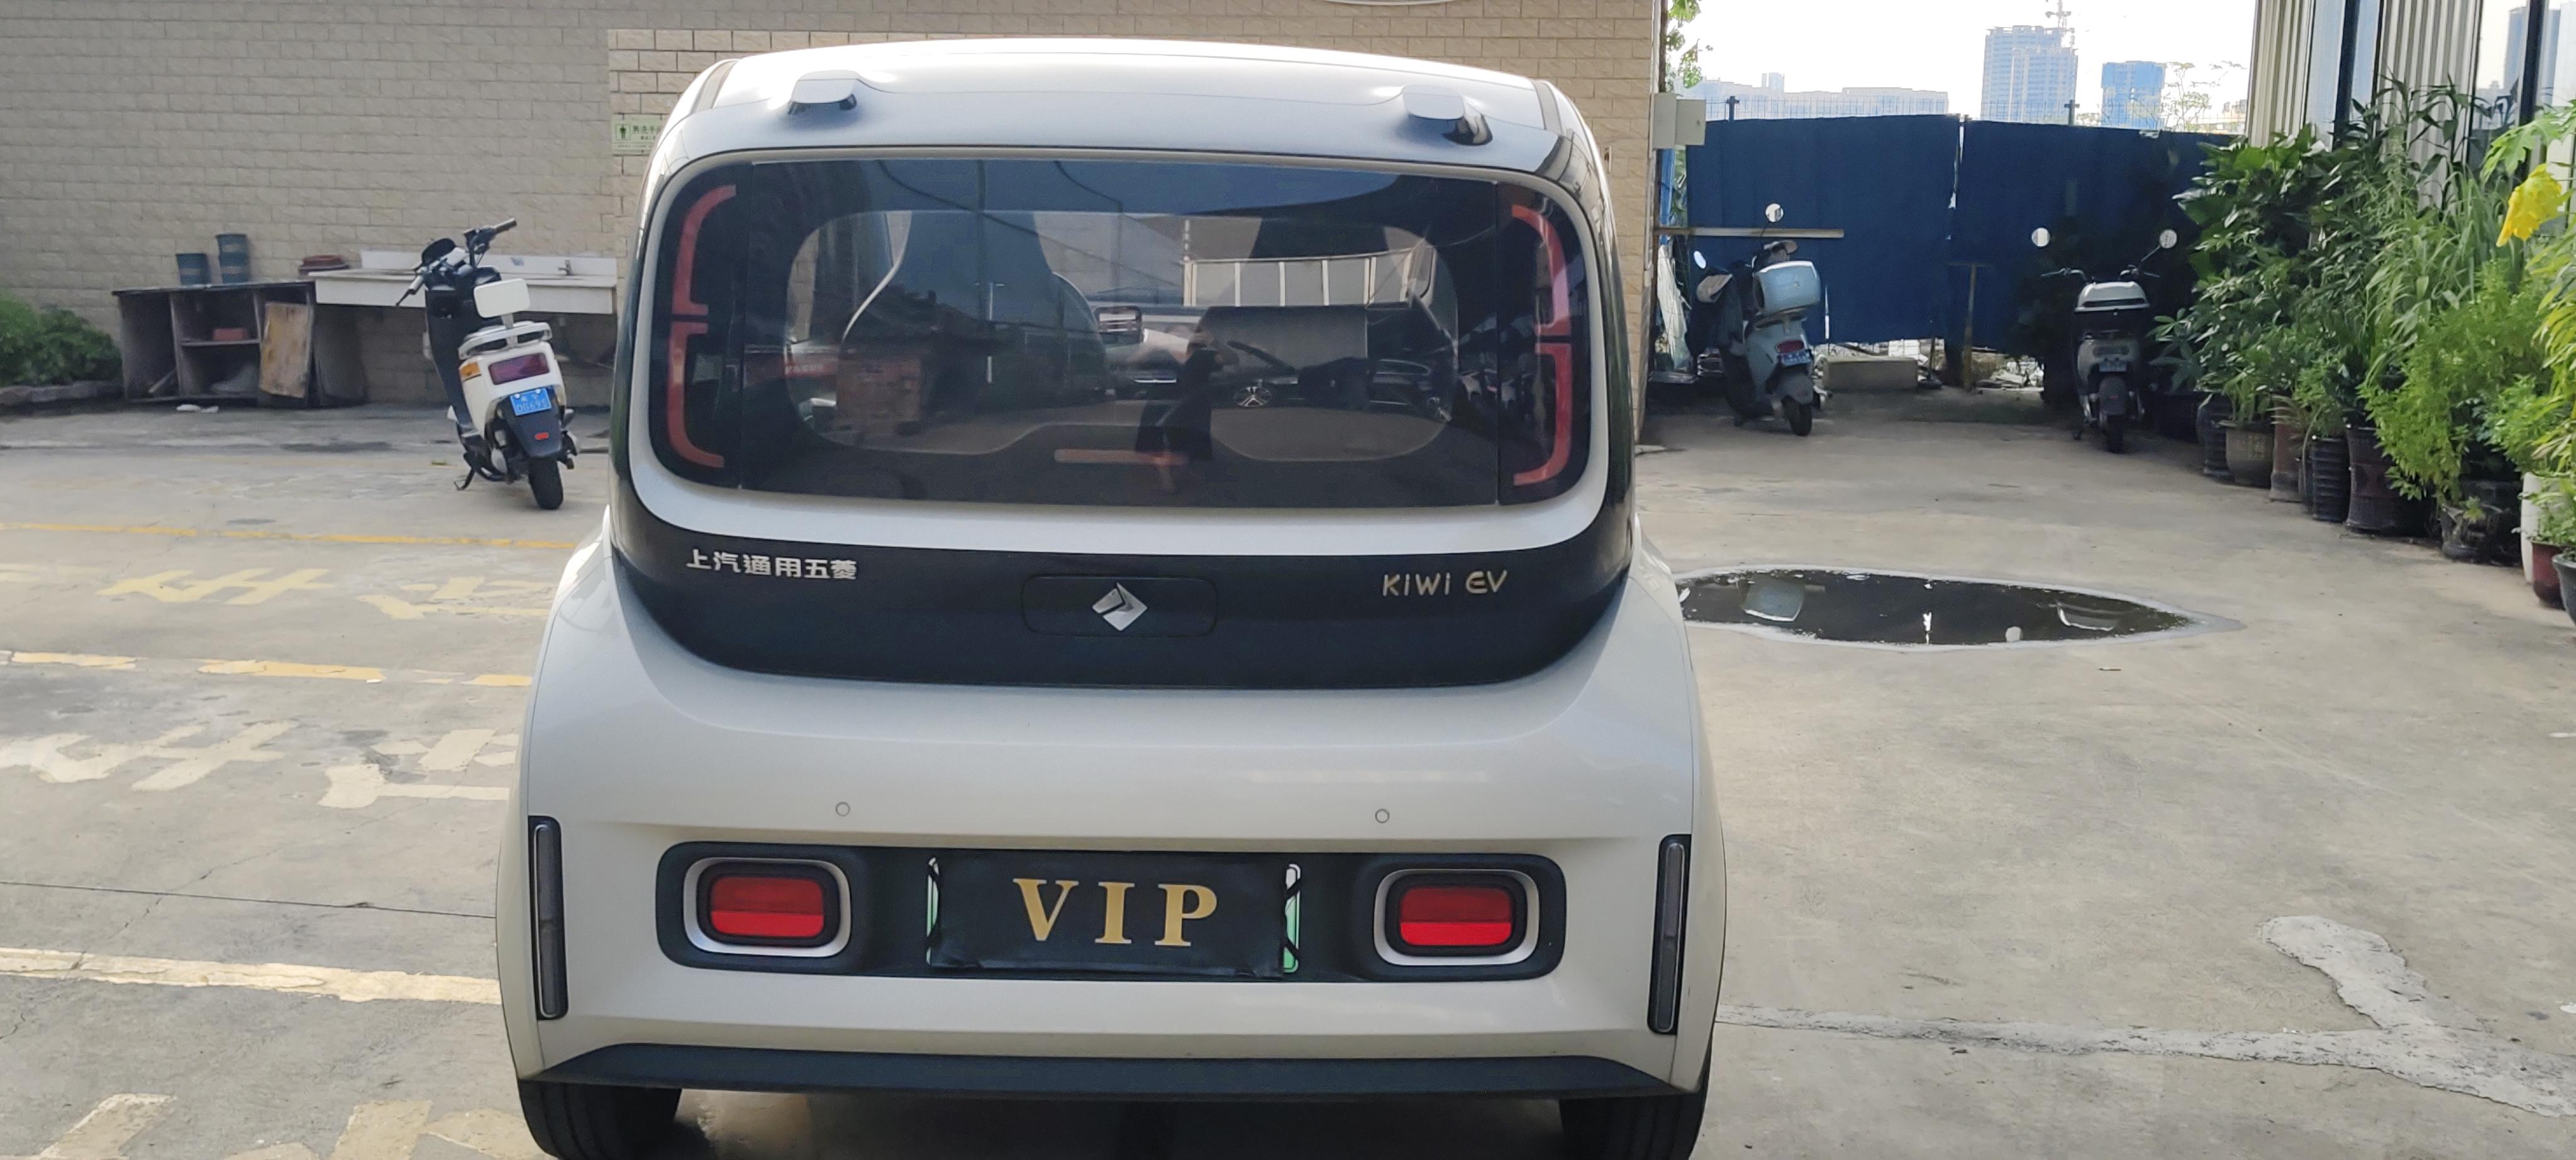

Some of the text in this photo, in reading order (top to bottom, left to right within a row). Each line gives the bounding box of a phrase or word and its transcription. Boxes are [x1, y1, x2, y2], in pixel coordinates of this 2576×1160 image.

[686, 549, 857, 580] 上汽通用五菱
[1465, 569, 1508, 594] EV
[1013, 878, 1218, 947] VIP
